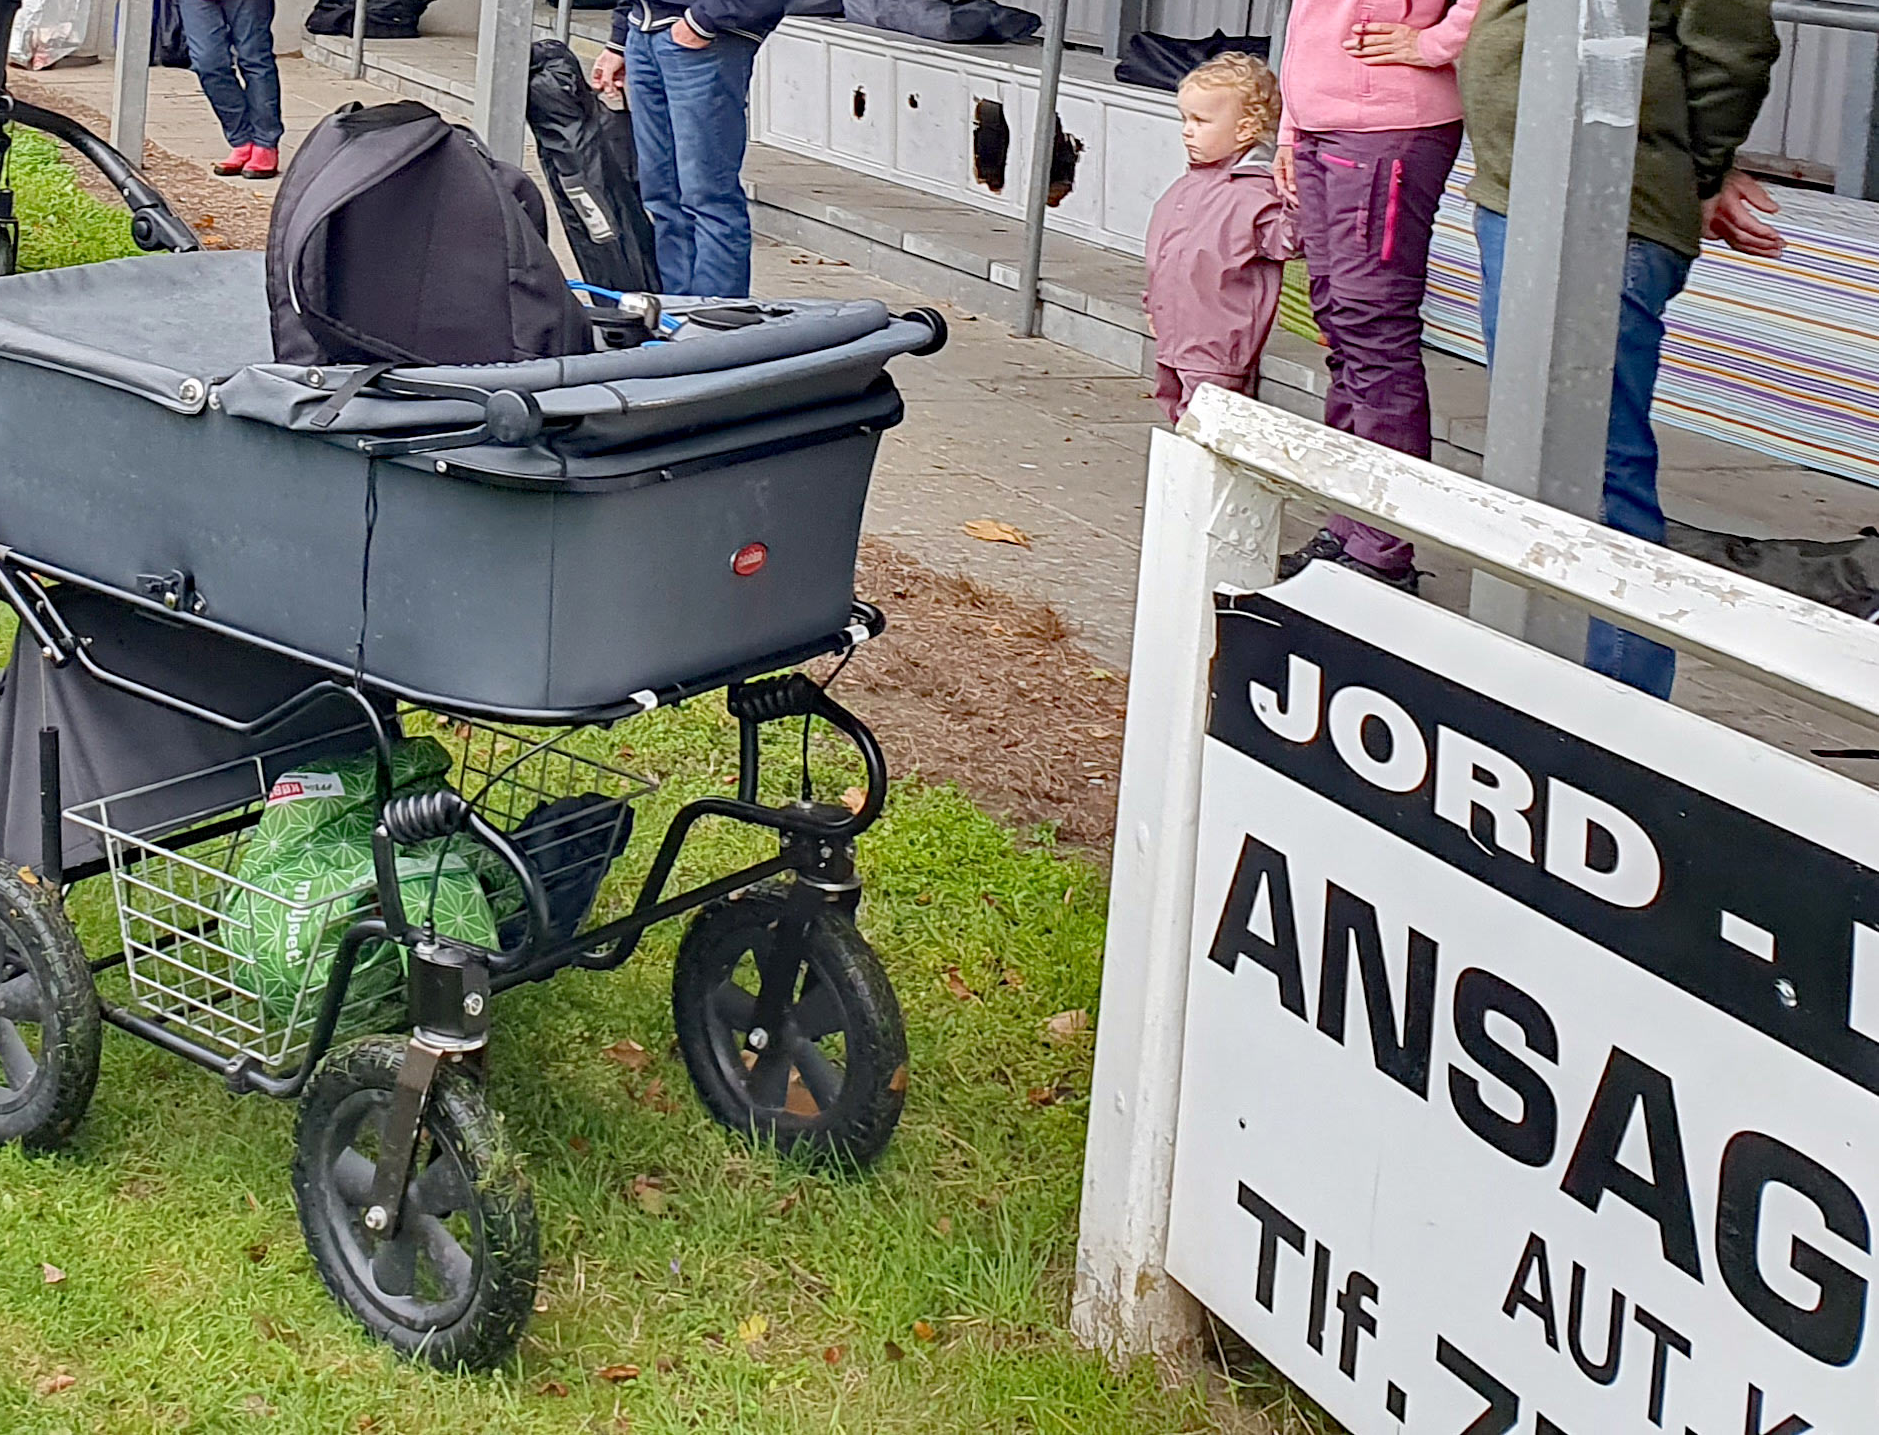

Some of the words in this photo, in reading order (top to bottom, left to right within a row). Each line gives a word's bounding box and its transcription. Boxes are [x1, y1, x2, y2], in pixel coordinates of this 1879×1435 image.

[1248, 653, 1663, 911] JORD
[1207, 831, 1872, 1369] ANSAG
[1501, 1230, 1696, 1435] AUT
